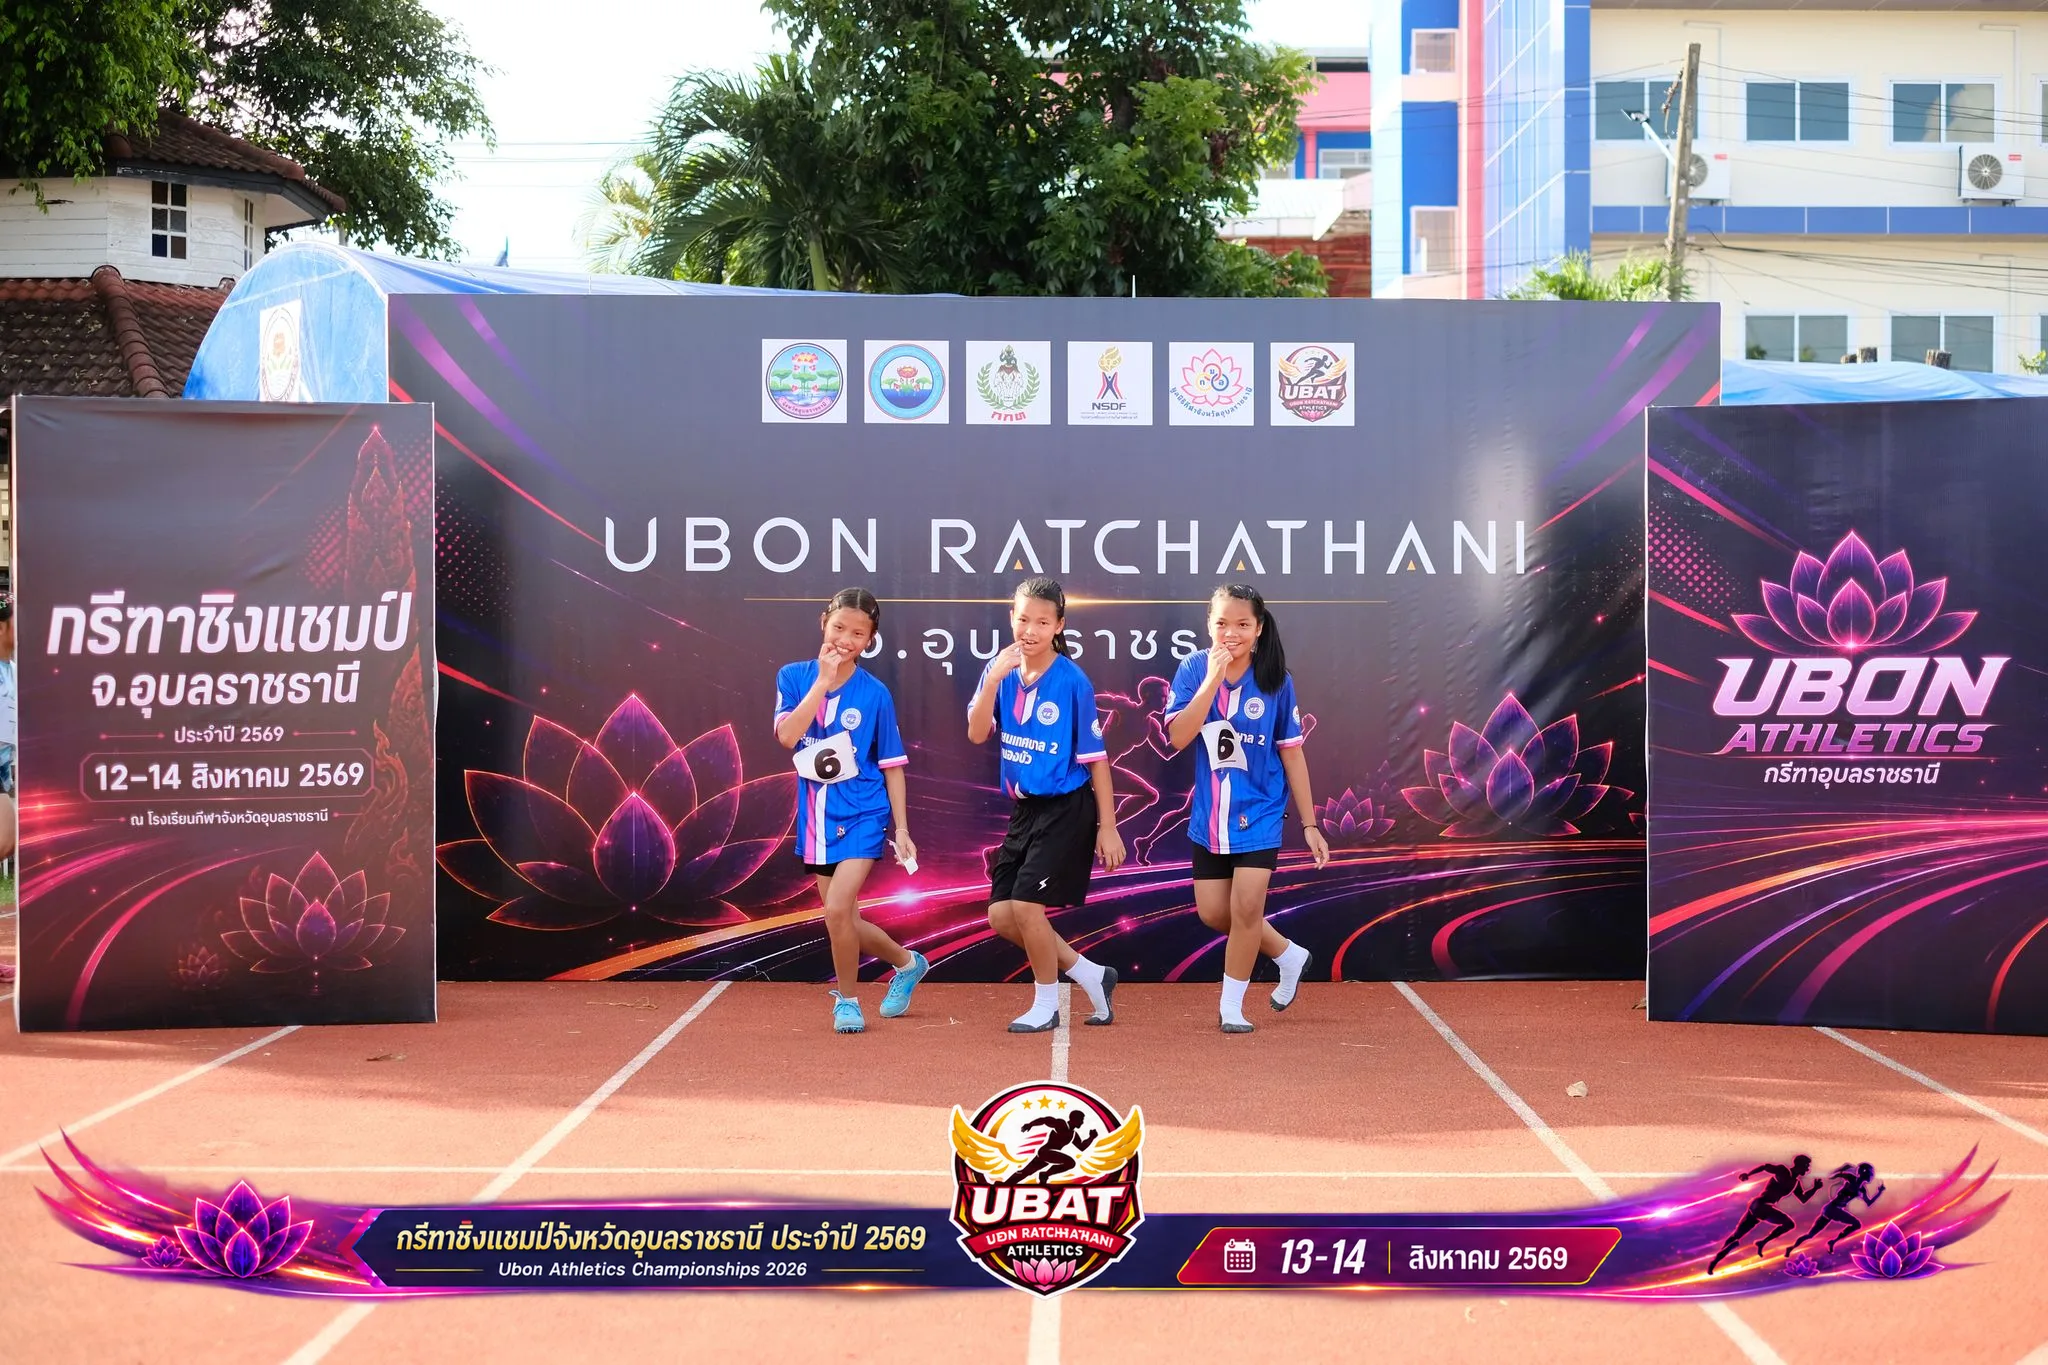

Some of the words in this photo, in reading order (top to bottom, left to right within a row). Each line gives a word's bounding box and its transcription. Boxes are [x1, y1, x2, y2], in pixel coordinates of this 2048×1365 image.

[1091, 402, 1127, 411] NSDF
[1284, 385, 1342, 400] UBAT
[604, 516, 878, 573] UBON
[930, 518, 1526, 574] RATCHATHANI
[46, 590, 413, 655] กรีฑาชิงแชมป์
[91, 660, 361, 719] จ.อุบลราชธานี
[1712, 656, 2012, 716] UBON
[173, 726, 235, 744] ประจำปี
[240, 726, 285, 743] 2569
[1049, 741, 1059, 755] 2
[1217, 728, 1235, 761] 6
[1257, 734, 1266, 746] 2
[1704, 723, 1997, 754] ATHLETICS
[191, 762, 290, 789] สิงหาคม
[298, 762, 365, 787] 2569
[813, 747, 842, 780] 6
[1763, 760, 1941, 790] กรีฑาอุบลราชธานี
[130, 815, 144, 826] ณ
[147, 808, 329, 827] โรงเรียนกีฬาจังหวัดอุบลราชธานี
